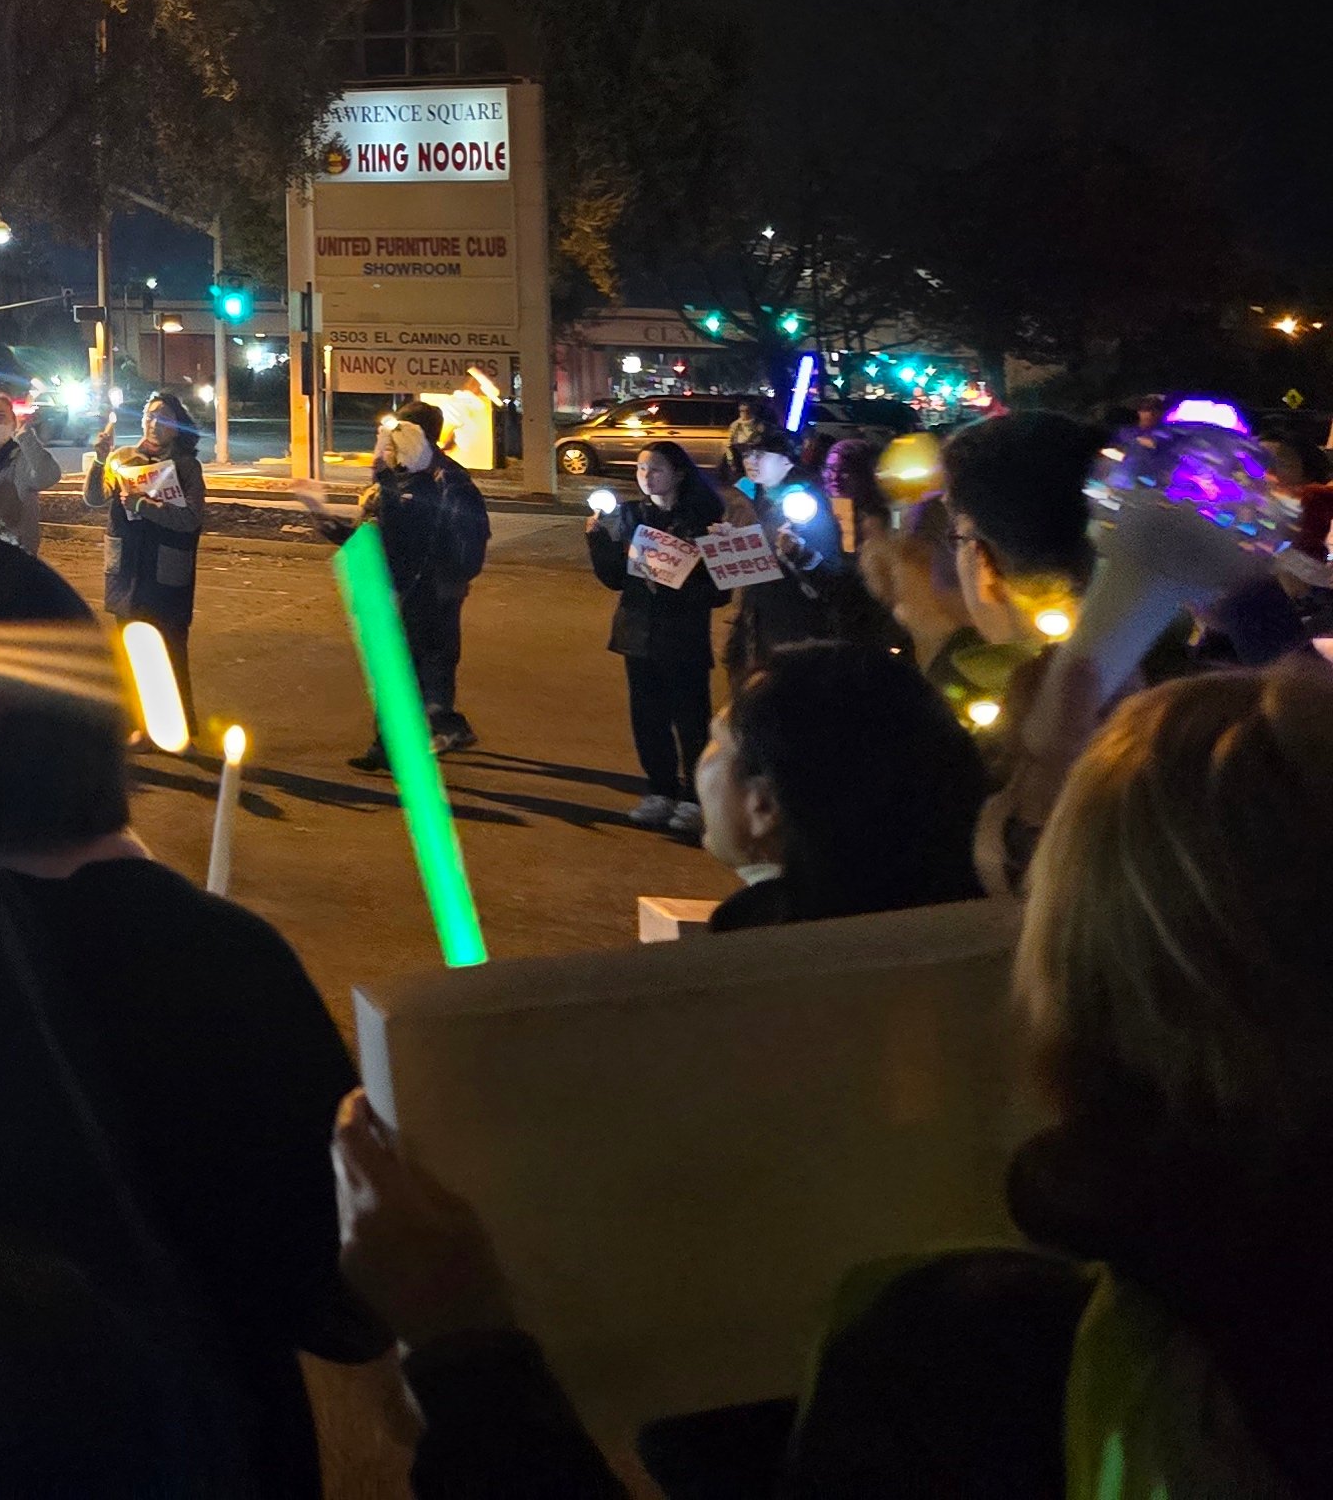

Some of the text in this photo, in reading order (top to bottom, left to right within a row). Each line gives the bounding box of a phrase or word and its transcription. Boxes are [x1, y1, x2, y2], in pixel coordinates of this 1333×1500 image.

[427, 102, 503, 125] SQUARE
[357, 141, 506, 172] KING NOODLE
[317, 236, 508, 257] UNITED FURNITURE CLUB
[362, 262, 462, 277] SHOWROOM
[329, 331, 512, 347] 3503 EL CAMINO REAL
[339, 355, 499, 378] NANCY CLEANERS
[639, 527, 700, 558] IMPEACH
